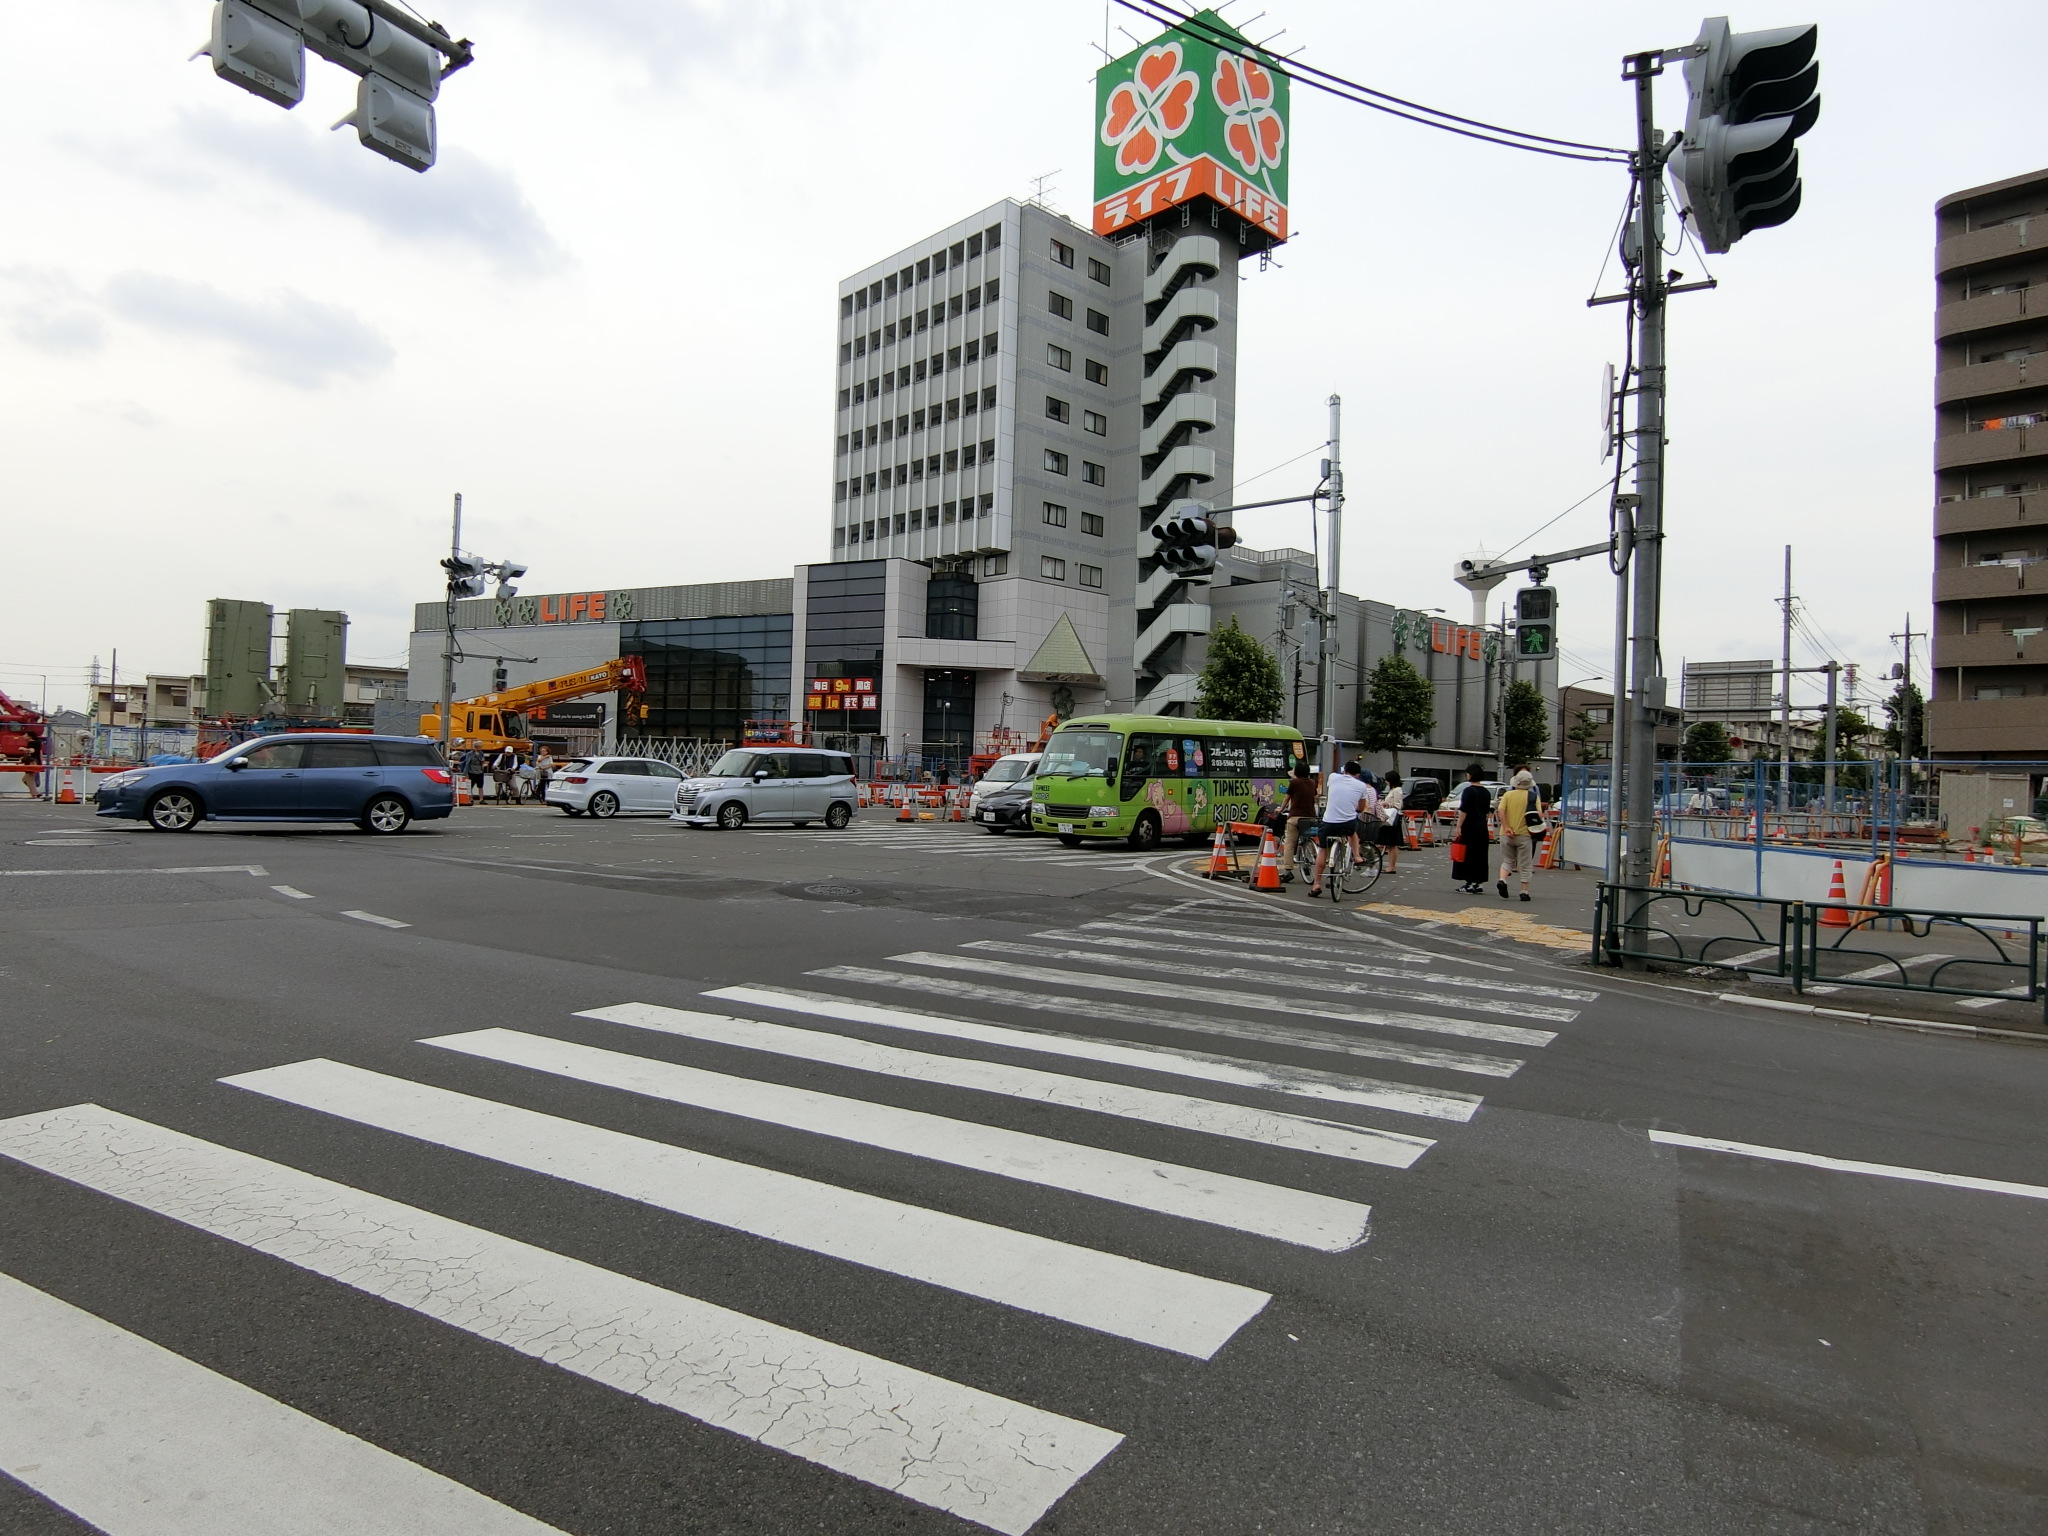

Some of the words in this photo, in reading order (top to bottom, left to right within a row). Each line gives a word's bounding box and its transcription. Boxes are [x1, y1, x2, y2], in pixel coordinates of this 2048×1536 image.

[1104, 168, 1191, 228] ライフ
[1215, 168, 1280, 233] LIFE
[541, 592, 606, 622] LIFE
[1431, 621, 1482, 662] LIFE
[590, 672, 608, 681] KATO
[1213, 779, 1250, 797] TIPNESS
[1213, 803, 1249, 822] KIDS
